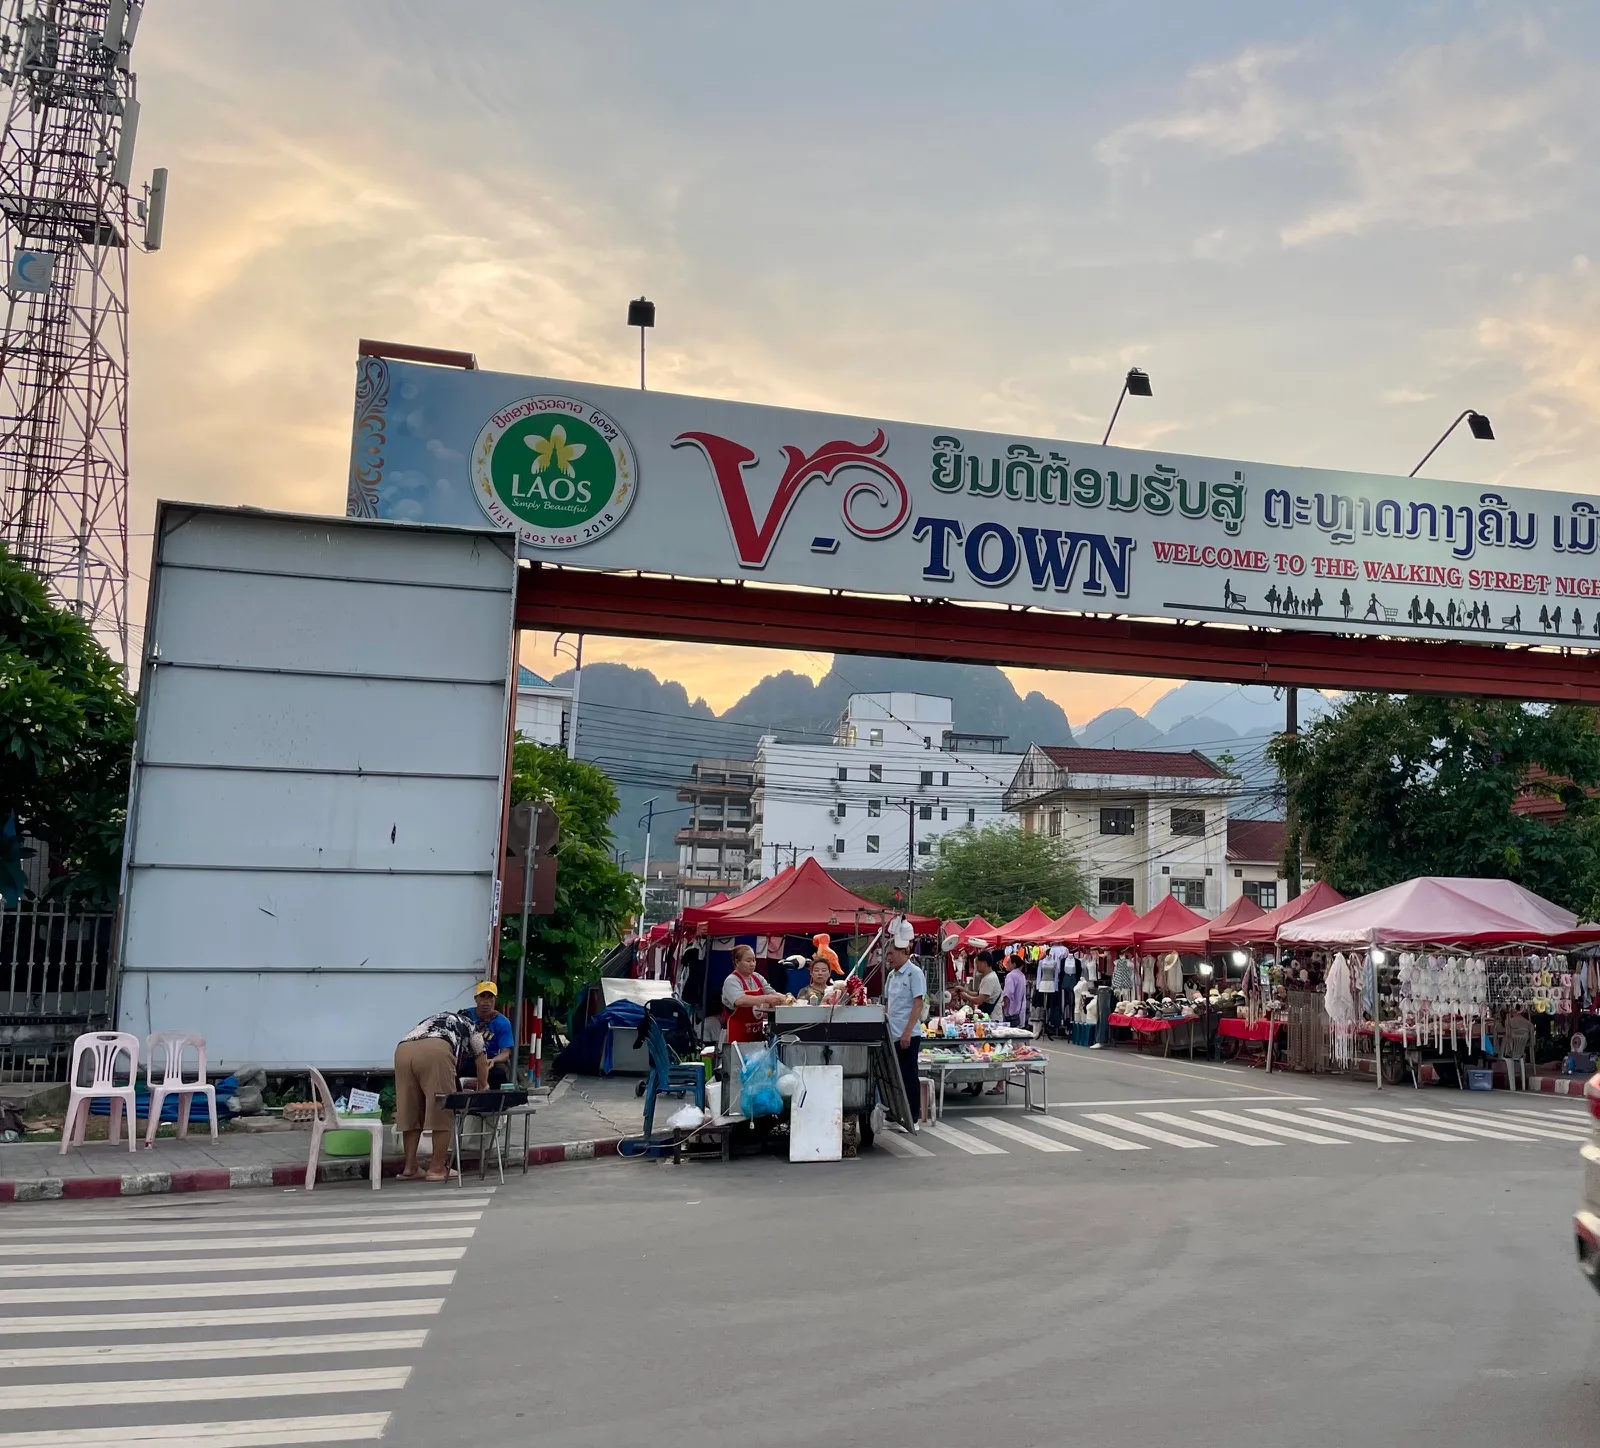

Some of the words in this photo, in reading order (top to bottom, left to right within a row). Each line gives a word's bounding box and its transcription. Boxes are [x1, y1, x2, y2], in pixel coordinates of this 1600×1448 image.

[511, 473, 592, 504] LAOS
[511, 497, 541, 511] Simply
[543, 501, 588, 514] Beautiful
[931, 435, 1244, 532] ຍິນດີຕ້ອນຮັບສູ່
[1553, 501, 1600, 551] ເມື
[488, 501, 514, 530] Visit
[550, 533, 578, 544] Year
[583, 513, 614, 538] 2018
[912, 516, 1134, 594] TOWN
[1152, 540, 1269, 571] WELCOME
[1274, 552, 1306, 575] TO
[1311, 555, 1358, 579] THE
[1362, 560, 1462, 587] WALKING
[1468, 568, 1550, 593] STREET
